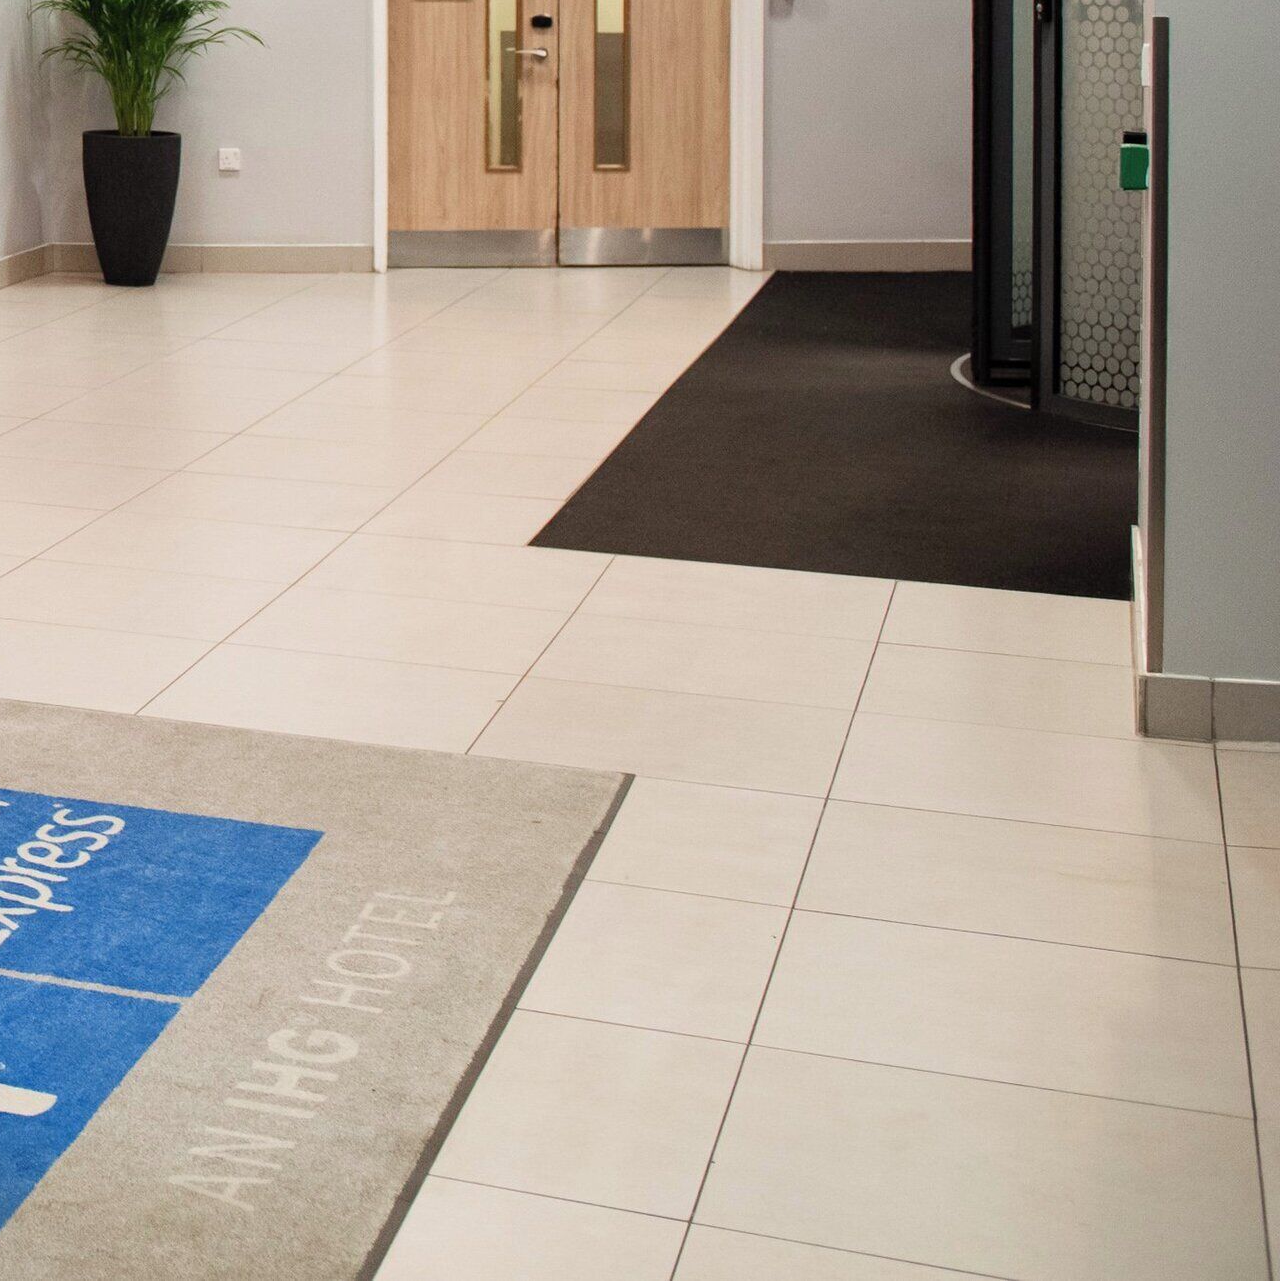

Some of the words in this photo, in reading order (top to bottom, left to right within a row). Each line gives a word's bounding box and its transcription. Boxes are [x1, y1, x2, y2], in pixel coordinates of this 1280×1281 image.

[297, 890, 457, 1015] HOTEL
[223, 1028, 360, 1120] IHG
[167, 1123, 297, 1213] AN
